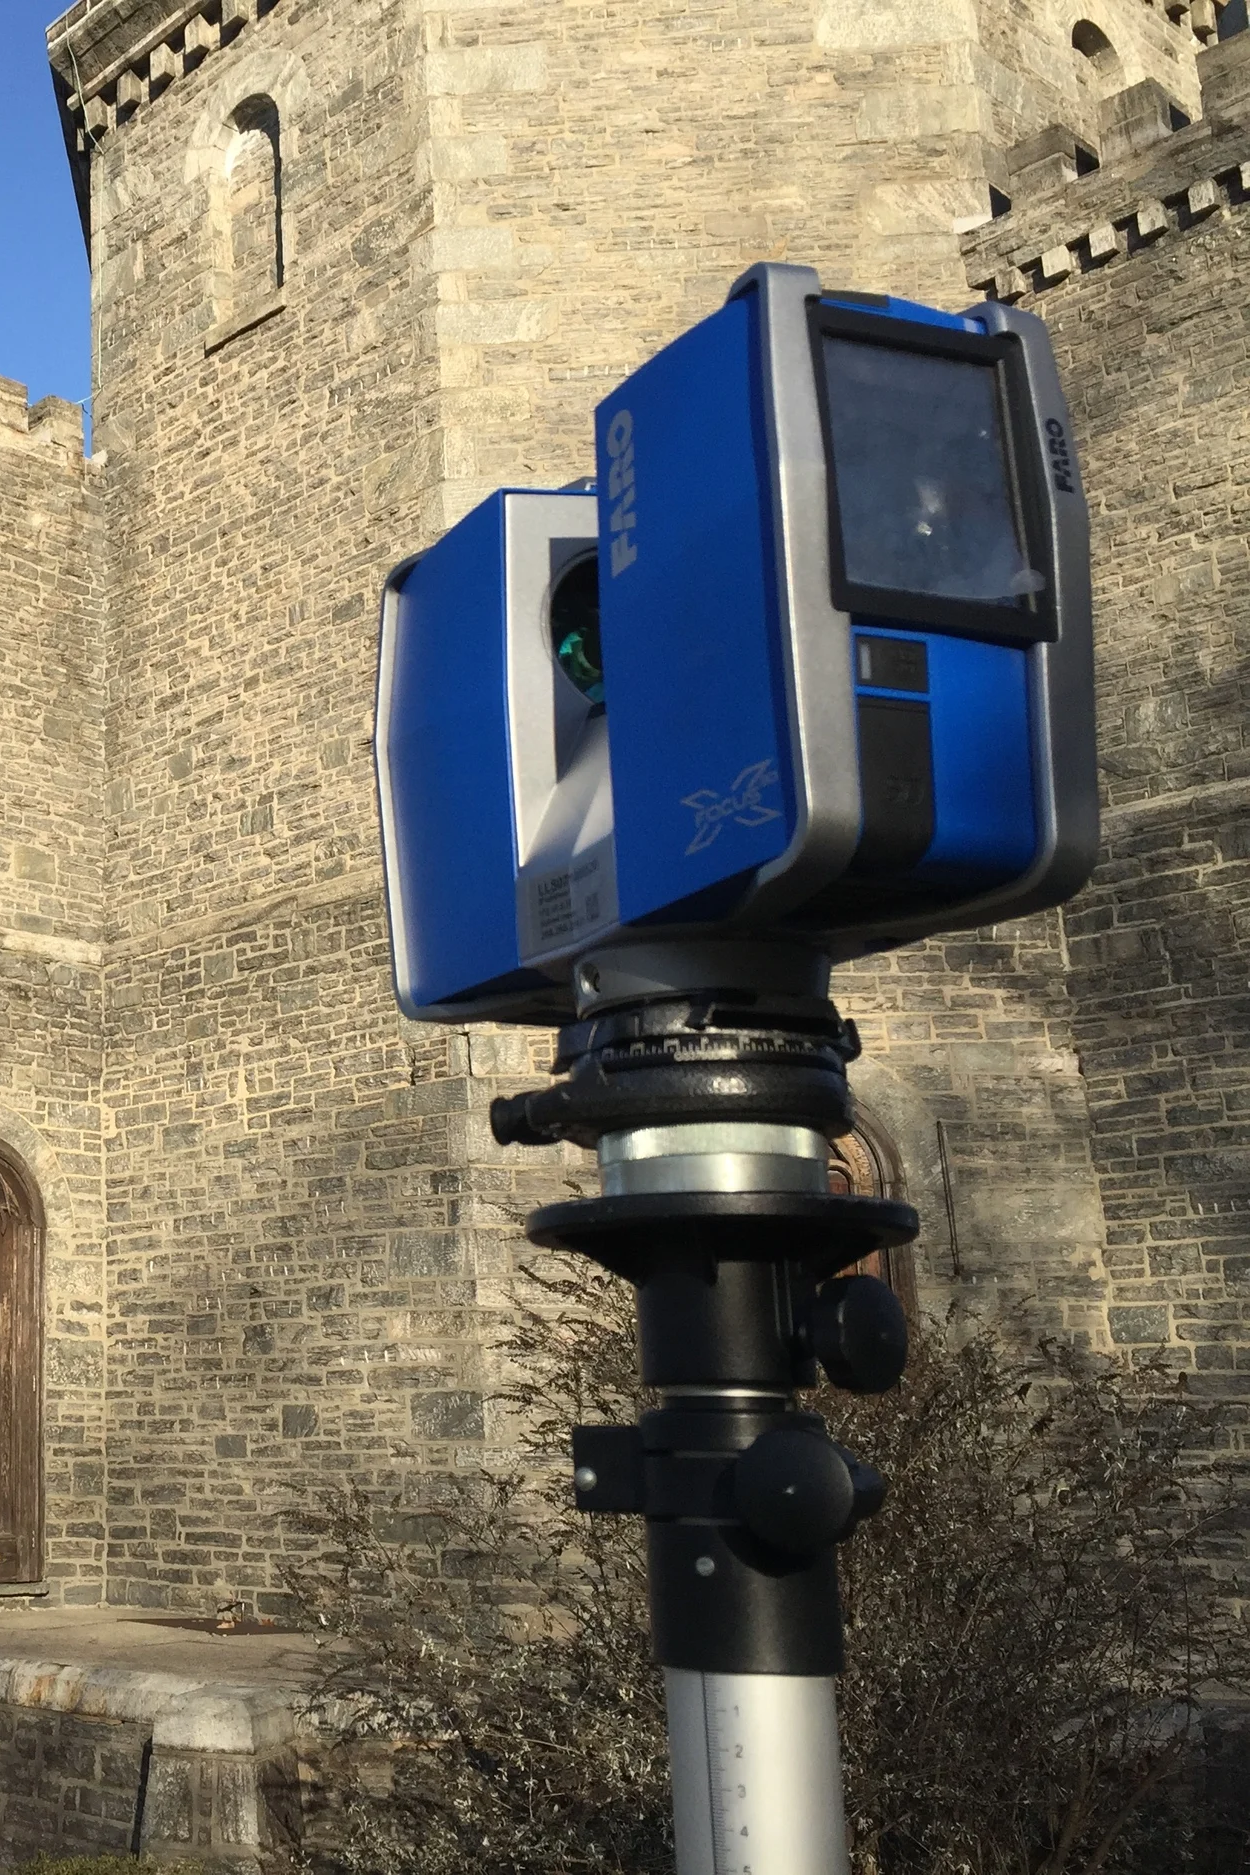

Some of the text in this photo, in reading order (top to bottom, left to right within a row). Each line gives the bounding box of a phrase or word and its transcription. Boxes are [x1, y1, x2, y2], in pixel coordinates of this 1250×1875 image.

[1045, 418, 1074, 493] FARO
[607, 409, 637, 578] FARO
[695, 788, 761, 829] FOCUS
[735, 1744, 743, 1758] 2
[737, 1783, 746, 1798] 3
[740, 1825, 749, 1838] 4
